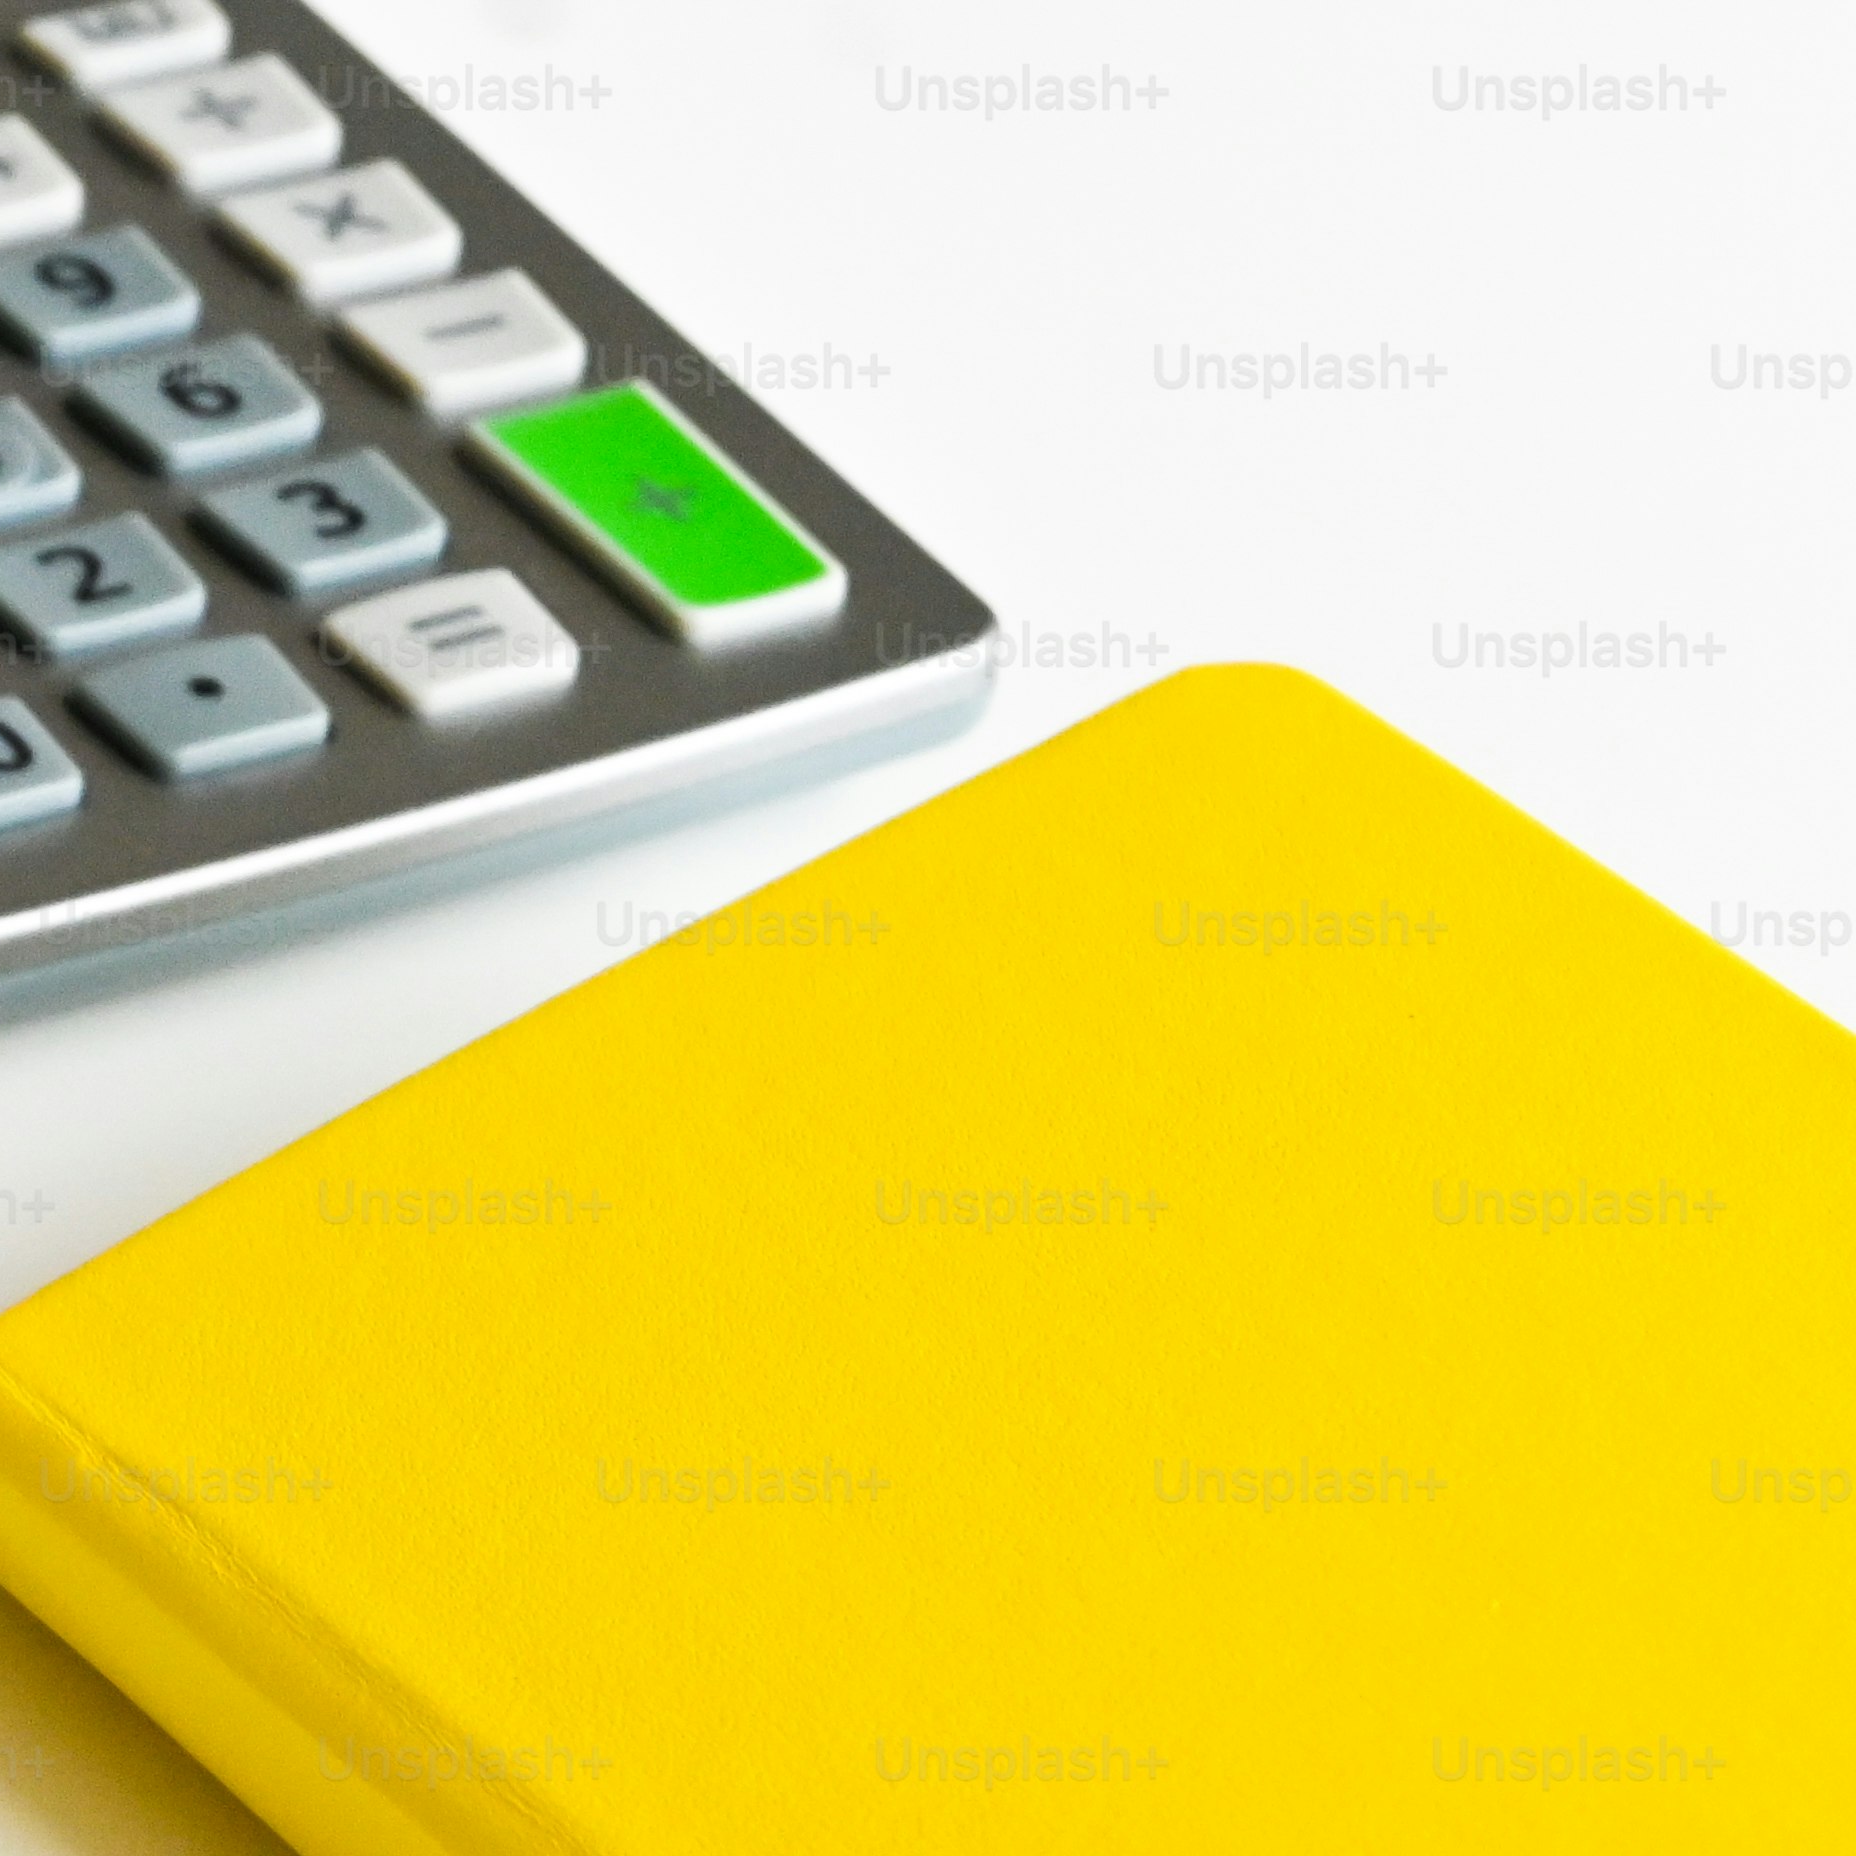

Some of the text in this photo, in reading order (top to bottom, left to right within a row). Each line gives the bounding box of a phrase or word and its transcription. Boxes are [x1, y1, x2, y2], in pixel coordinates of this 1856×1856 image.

[35, 253, 116, 312] 9
[157, 360, 245, 420] 6
[277, 478, 368, 541] 3
[33, 544, 137, 607] 2
